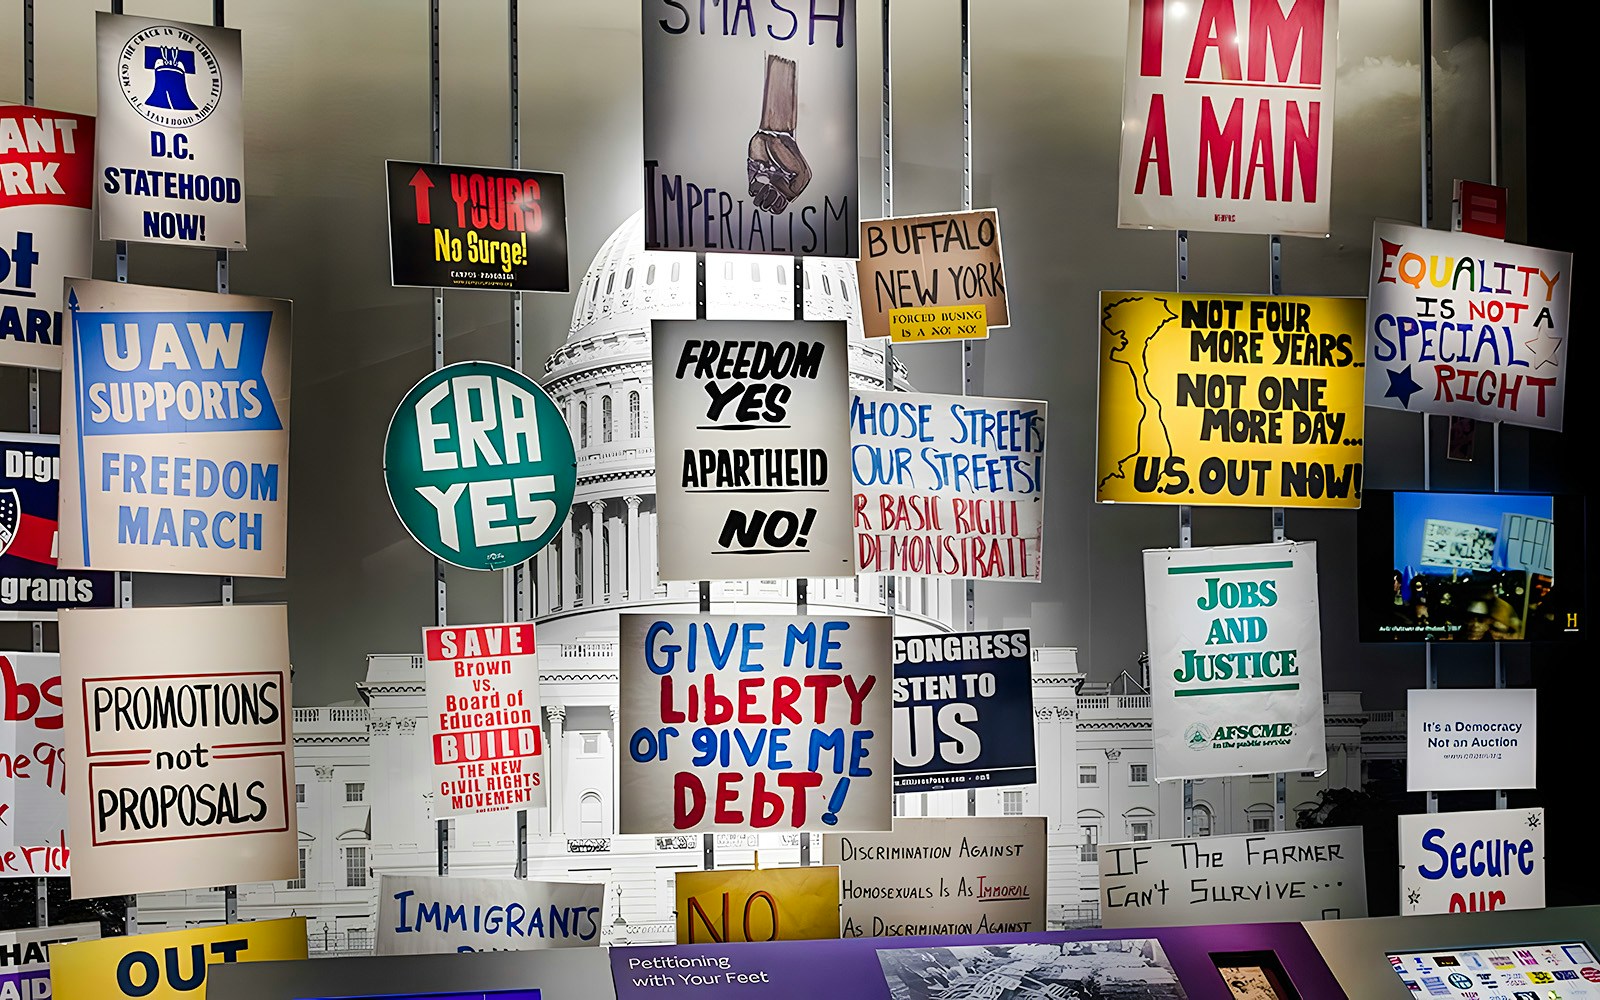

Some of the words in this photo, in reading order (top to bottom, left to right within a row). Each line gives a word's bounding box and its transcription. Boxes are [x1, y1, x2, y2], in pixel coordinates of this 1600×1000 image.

[178, 31, 194, 44] THE
[659, 0, 844, 48] SMASH
[1140, 0, 1164, 77] I
[1185, 0, 1326, 84] AM
[150, 130, 194, 160] D.C.
[1134, 93, 1173, 196] A
[1197, 95, 1321, 203] MAN
[0, 161, 66, 195] RK
[103, 166, 241, 204] STATEHOOD
[450, 173, 544, 233] YOURS
[644, 160, 849, 256] IMPERIALISM
[143, 210, 206, 241] NOW!
[867, 217, 995, 258] BUFFALO
[434, 228, 462, 263] No
[467, 230, 528, 273] Surge!
[1377, 238, 1560, 301] EQUALITY
[875, 268, 938, 313] NEW
[948, 262, 1005, 301] YORK
[893, 313, 936, 324] FORCED
[901, 328, 911, 338] IS
[917, 328, 925, 337] A
[1181, 300, 1243, 330] NOT
[1250, 301, 1311, 333] FOUR
[1416, 297, 1455, 319] IS
[1468, 299, 1529, 324] NOT
[1533, 307, 1554, 329] A
[101, 322, 244, 372] UAW
[675, 339, 825, 381] FREEDOM
[1190, 330, 1263, 364] MORE
[1374, 313, 1530, 367] SPECIAL
[88, 379, 262, 423] SUPPORTS
[704, 380, 792, 423] YES
[1176, 373, 1247, 409] NOT
[1258, 376, 1328, 413] ONE
[1433, 364, 1557, 418] RIGHT
[415, 375, 542, 472] ERA
[950, 404, 1044, 453] STREETS
[1200, 409, 1283, 444] MORE
[101, 452, 278, 502] FREEDOM
[682, 448, 828, 488] APARTHEID
[852, 444, 915, 489] OUR
[921, 447, 1042, 503] STREETS!
[1133, 456, 1195, 494] U.S.
[1199, 456, 1272, 496] OUT
[1281, 461, 1363, 500] NOW!
[118, 505, 262, 551] MARCH
[414, 475, 557, 553] YES
[718, 507, 817, 549] NO!
[879, 493, 944, 531] BASIC
[952, 497, 1022, 537] RIGHT
[858, 532, 1034, 578] DEMONSTRATE
[1, 576, 94, 604] grants
[1197, 578, 1278, 611] JOBS
[1205, 616, 1268, 645] AND
[1567, 613, 1577, 628] H
[440, 626, 523, 659] SAVE
[645, 621, 765, 675] GIVE
[783, 621, 850, 670] ME
[893, 633, 1028, 665] CONGRESS
[454, 659, 512, 678] Brown
[472, 679, 496, 692] vs.
[962, 672, 996, 698] TO
[1173, 649, 1299, 683] JUSTICE
[94, 681, 279, 732] PROMOTIONS
[440, 708, 531, 731] Education
[446, 691, 500, 713] Board
[507, 689, 523, 707] of
[440, 727, 535, 764] BUILD
[893, 702, 981, 768] US
[1211, 723, 1293, 740] AFSCME
[1423, 721, 1441, 732] It's
[1445, 724, 1452, 732] a
[1455, 721, 1522, 734] Democracy
[1428, 737, 1450, 748] Not
[1453, 739, 1468, 748] an
[1471, 737, 1518, 748] Auction
[156, 742, 209, 770] not
[458, 763, 485, 779] THE
[491, 760, 522, 776] NEW
[630, 726, 679, 763] or
[808, 727, 874, 777] ME
[441, 779, 481, 796] CIVIL
[487, 772, 541, 791] RIGHTS
[452, 788, 532, 810] MOVEMENT
[98, 780, 267, 832] PROPOSALS
[1105, 846, 1152, 877] IF
[1246, 837, 1344, 866] FARMER
[1418, 828, 1534, 880] Secure
[393, 890, 600, 941] IMMIGRANTS
[687, 890, 780, 944] NO
[117, 938, 249, 998] OUT
[628, 954, 731, 971] Petitioning
[632, 972, 675, 987] with
[678, 972, 722, 986] Your
[725, 970, 769, 984] Feet
